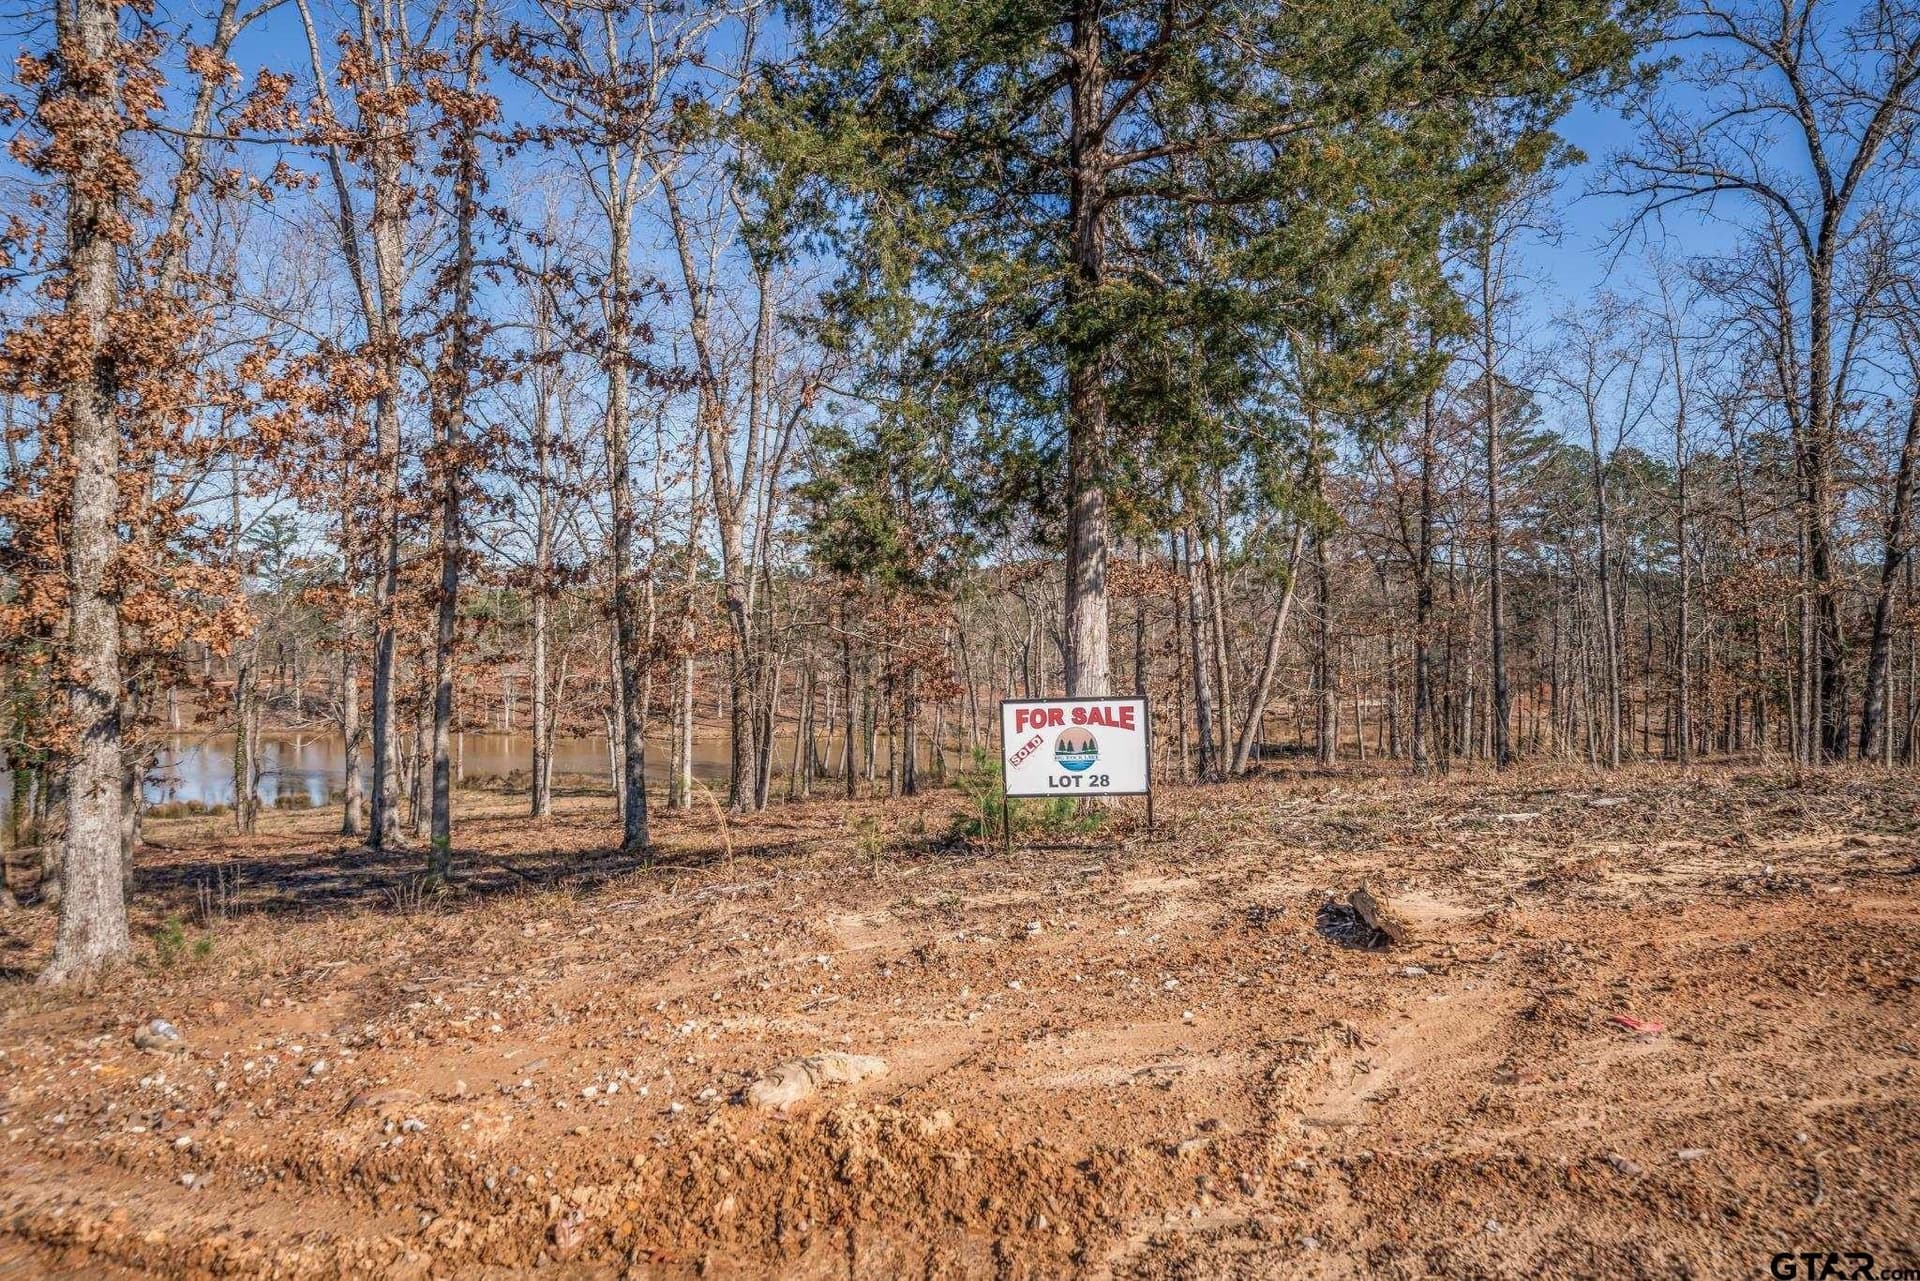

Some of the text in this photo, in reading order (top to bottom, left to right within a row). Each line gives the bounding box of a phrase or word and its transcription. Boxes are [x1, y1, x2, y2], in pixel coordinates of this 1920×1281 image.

[1015, 706, 1135, 733] FOR SALE
[1010, 735, 1043, 767] SOLD
[1048, 774, 1110, 788] LOT 28
